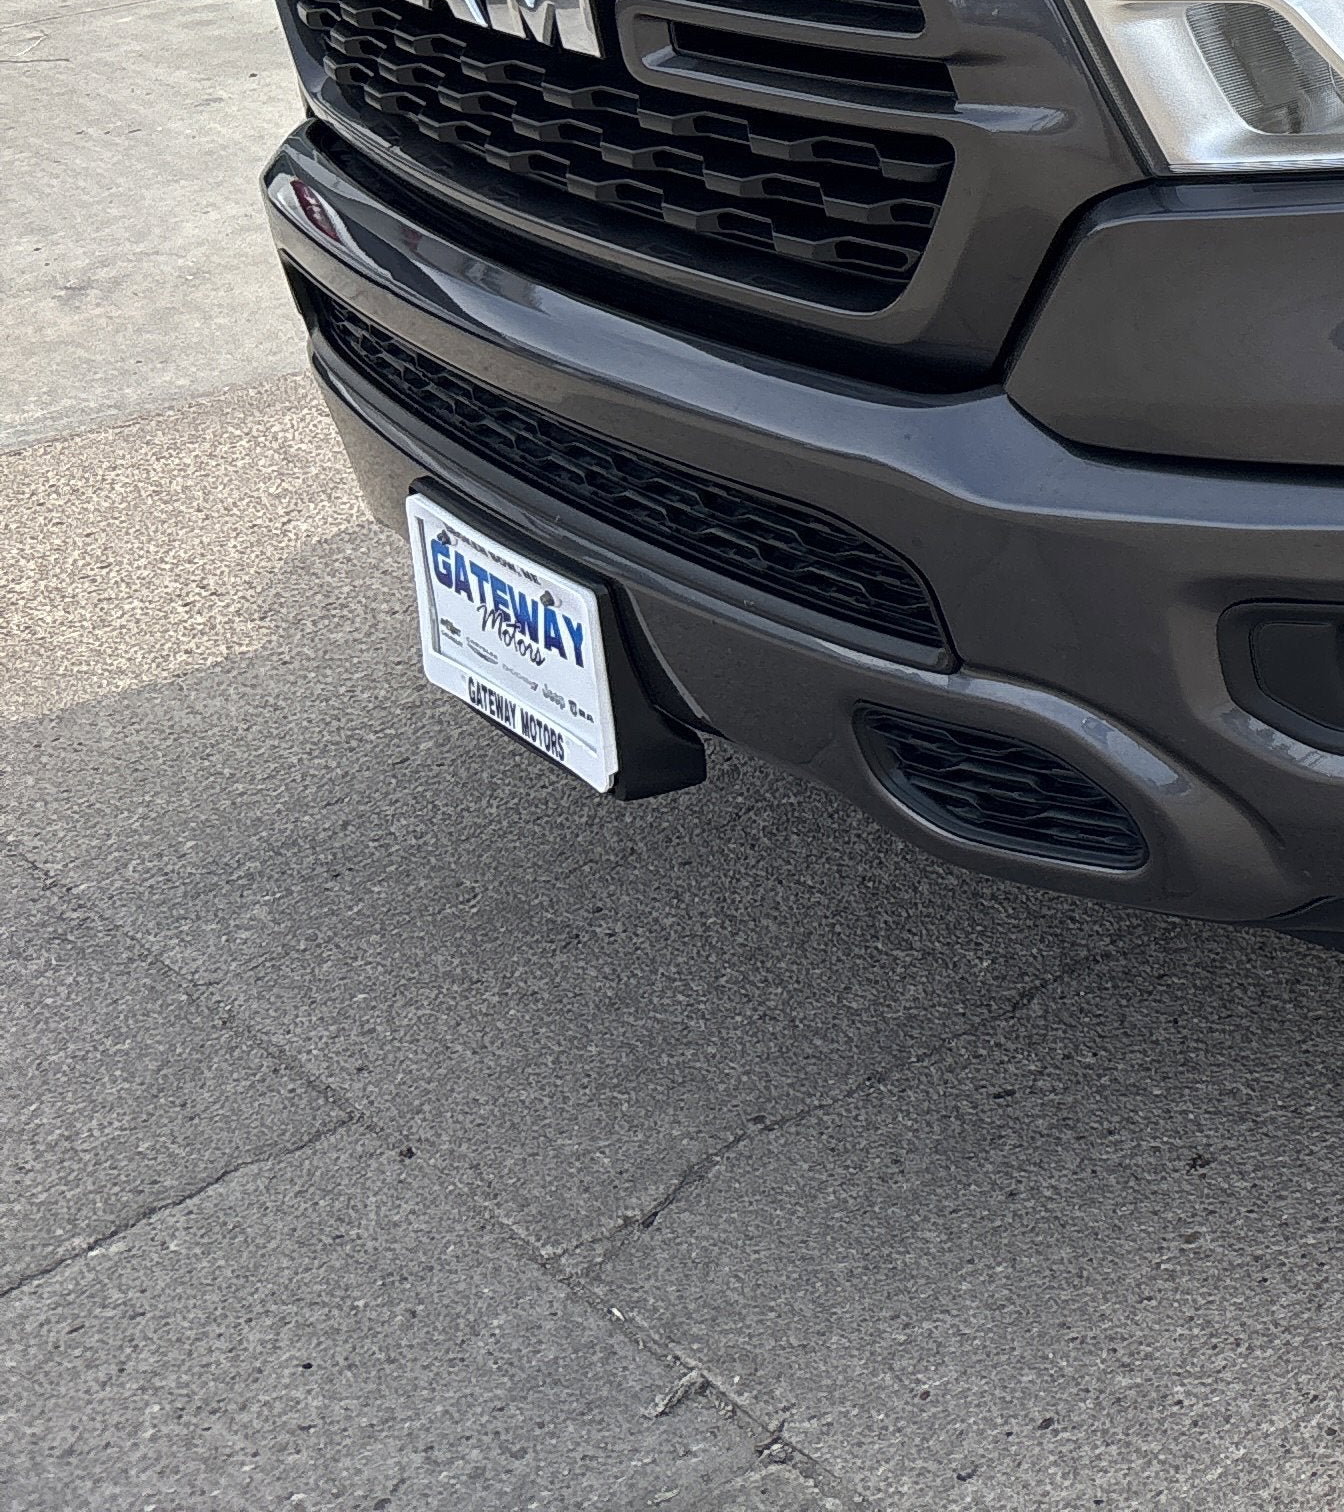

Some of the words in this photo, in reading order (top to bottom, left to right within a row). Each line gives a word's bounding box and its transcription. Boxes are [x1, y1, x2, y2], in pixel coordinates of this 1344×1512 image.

[430, 537, 585, 669] GATEWAY
[476, 603, 546, 666] Motors
[467, 676, 517, 730] GATEWAY
[519, 707, 565, 762] MOTORS
